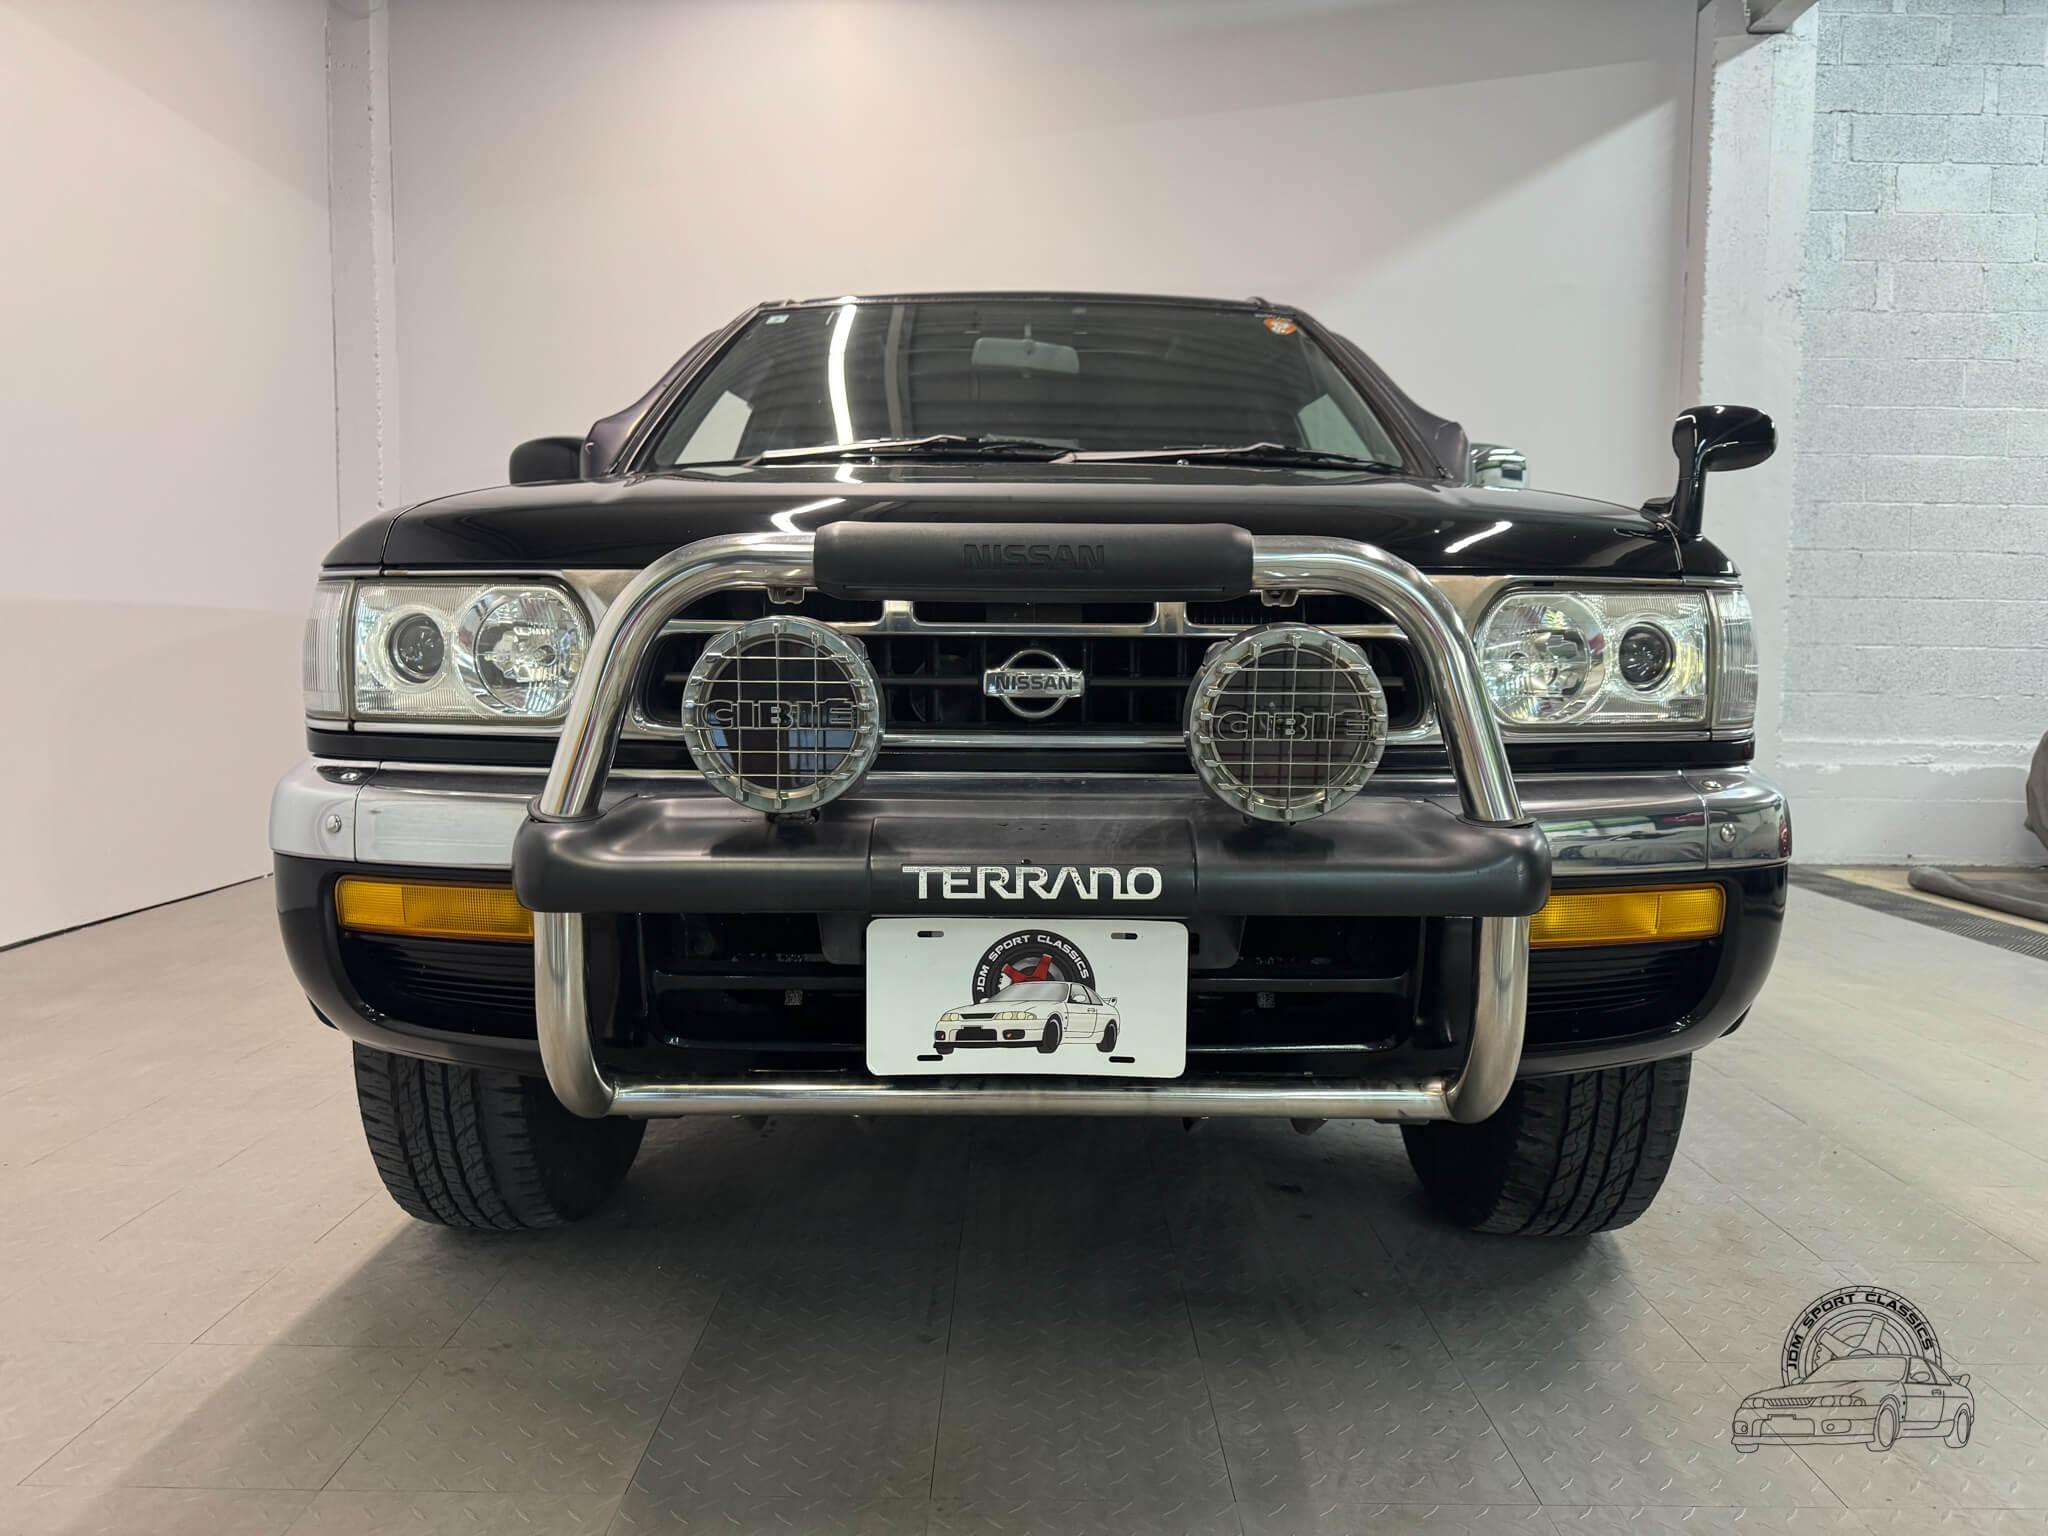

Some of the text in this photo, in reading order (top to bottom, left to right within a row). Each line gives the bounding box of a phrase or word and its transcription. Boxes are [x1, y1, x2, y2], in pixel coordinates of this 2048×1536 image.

[963, 544, 1104, 569] NISSAN
[995, 675, 1073, 690] NISSAN
[902, 866, 1162, 900] TERRANO
[976, 934, 1089, 993] JDM SPORT CLASSICS
